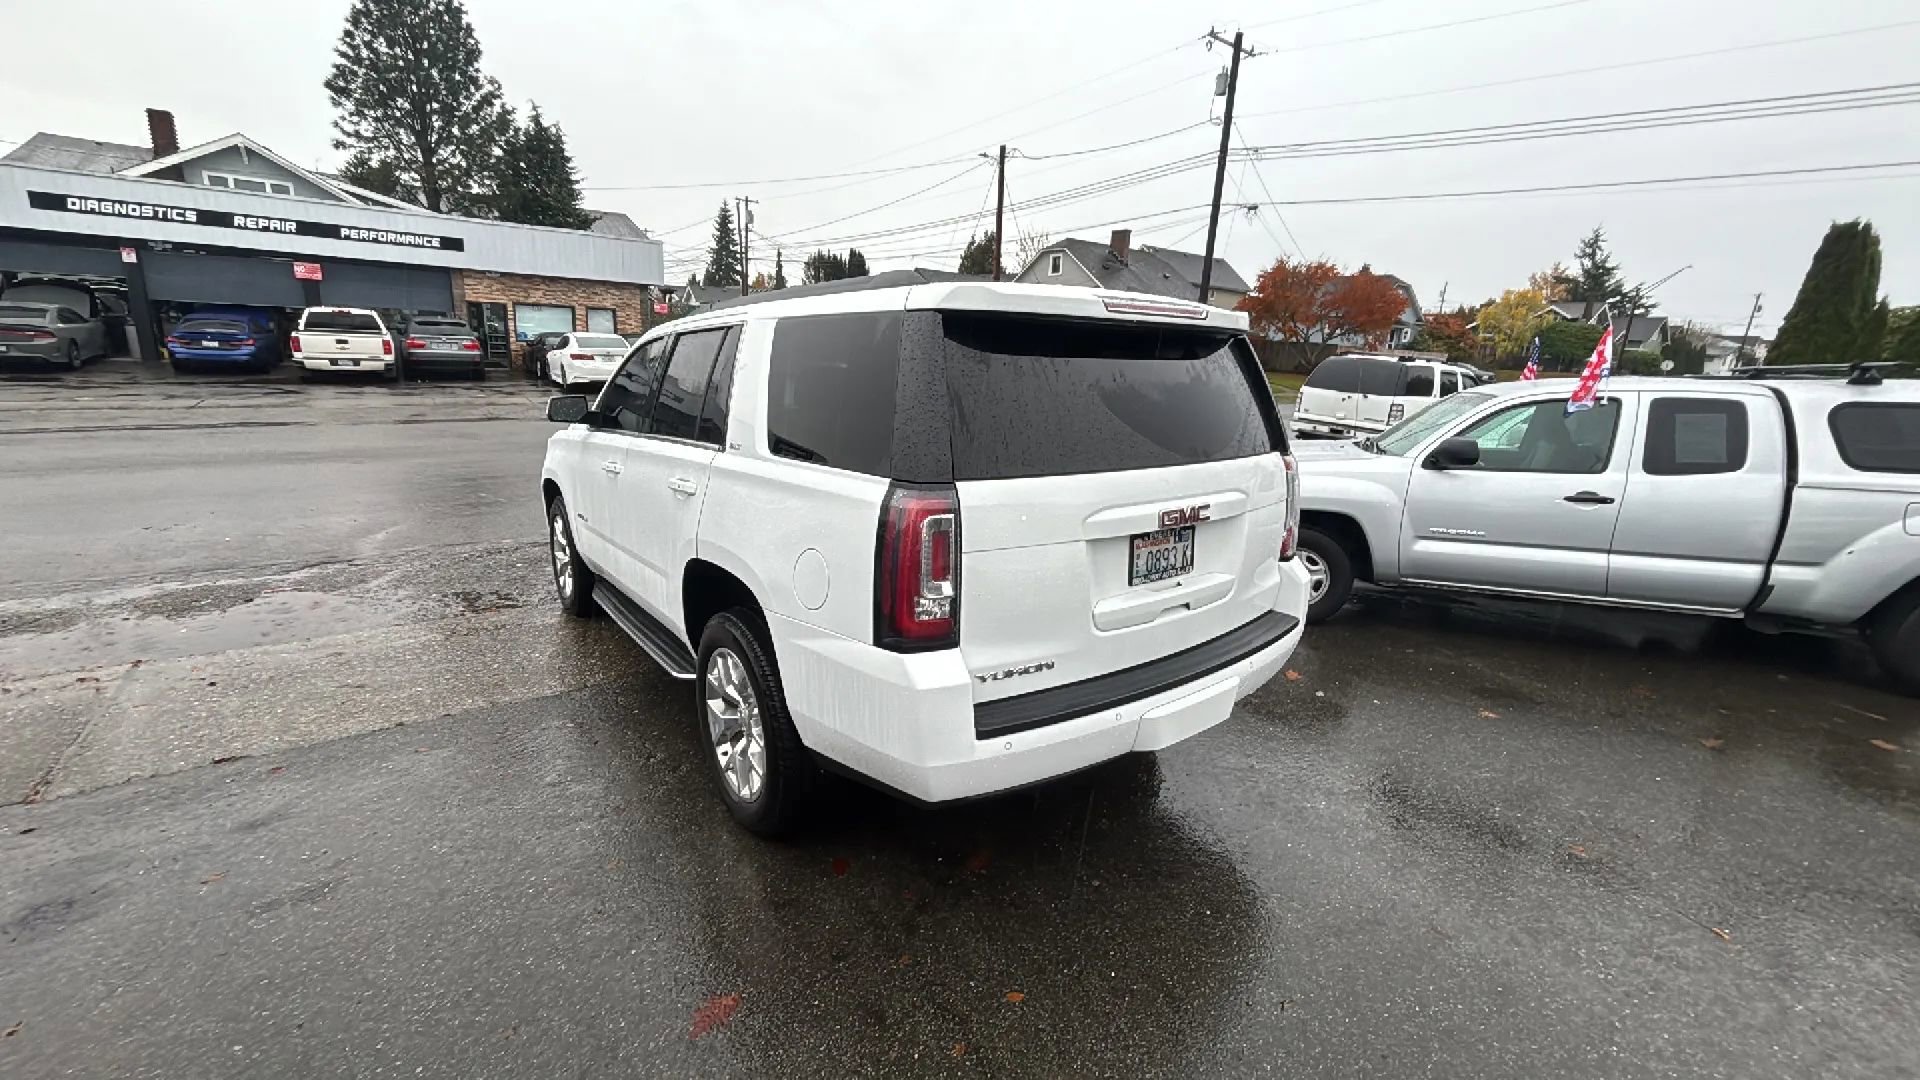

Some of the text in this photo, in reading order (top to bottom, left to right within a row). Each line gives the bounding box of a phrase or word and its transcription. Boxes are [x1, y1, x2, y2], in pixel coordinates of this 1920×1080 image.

[66, 198, 441, 248] DIAGNOSTICS REPAIR PERFORMANCE
[1158, 504, 1211, 528] GMC
[974, 660, 1056, 683] YUKON
